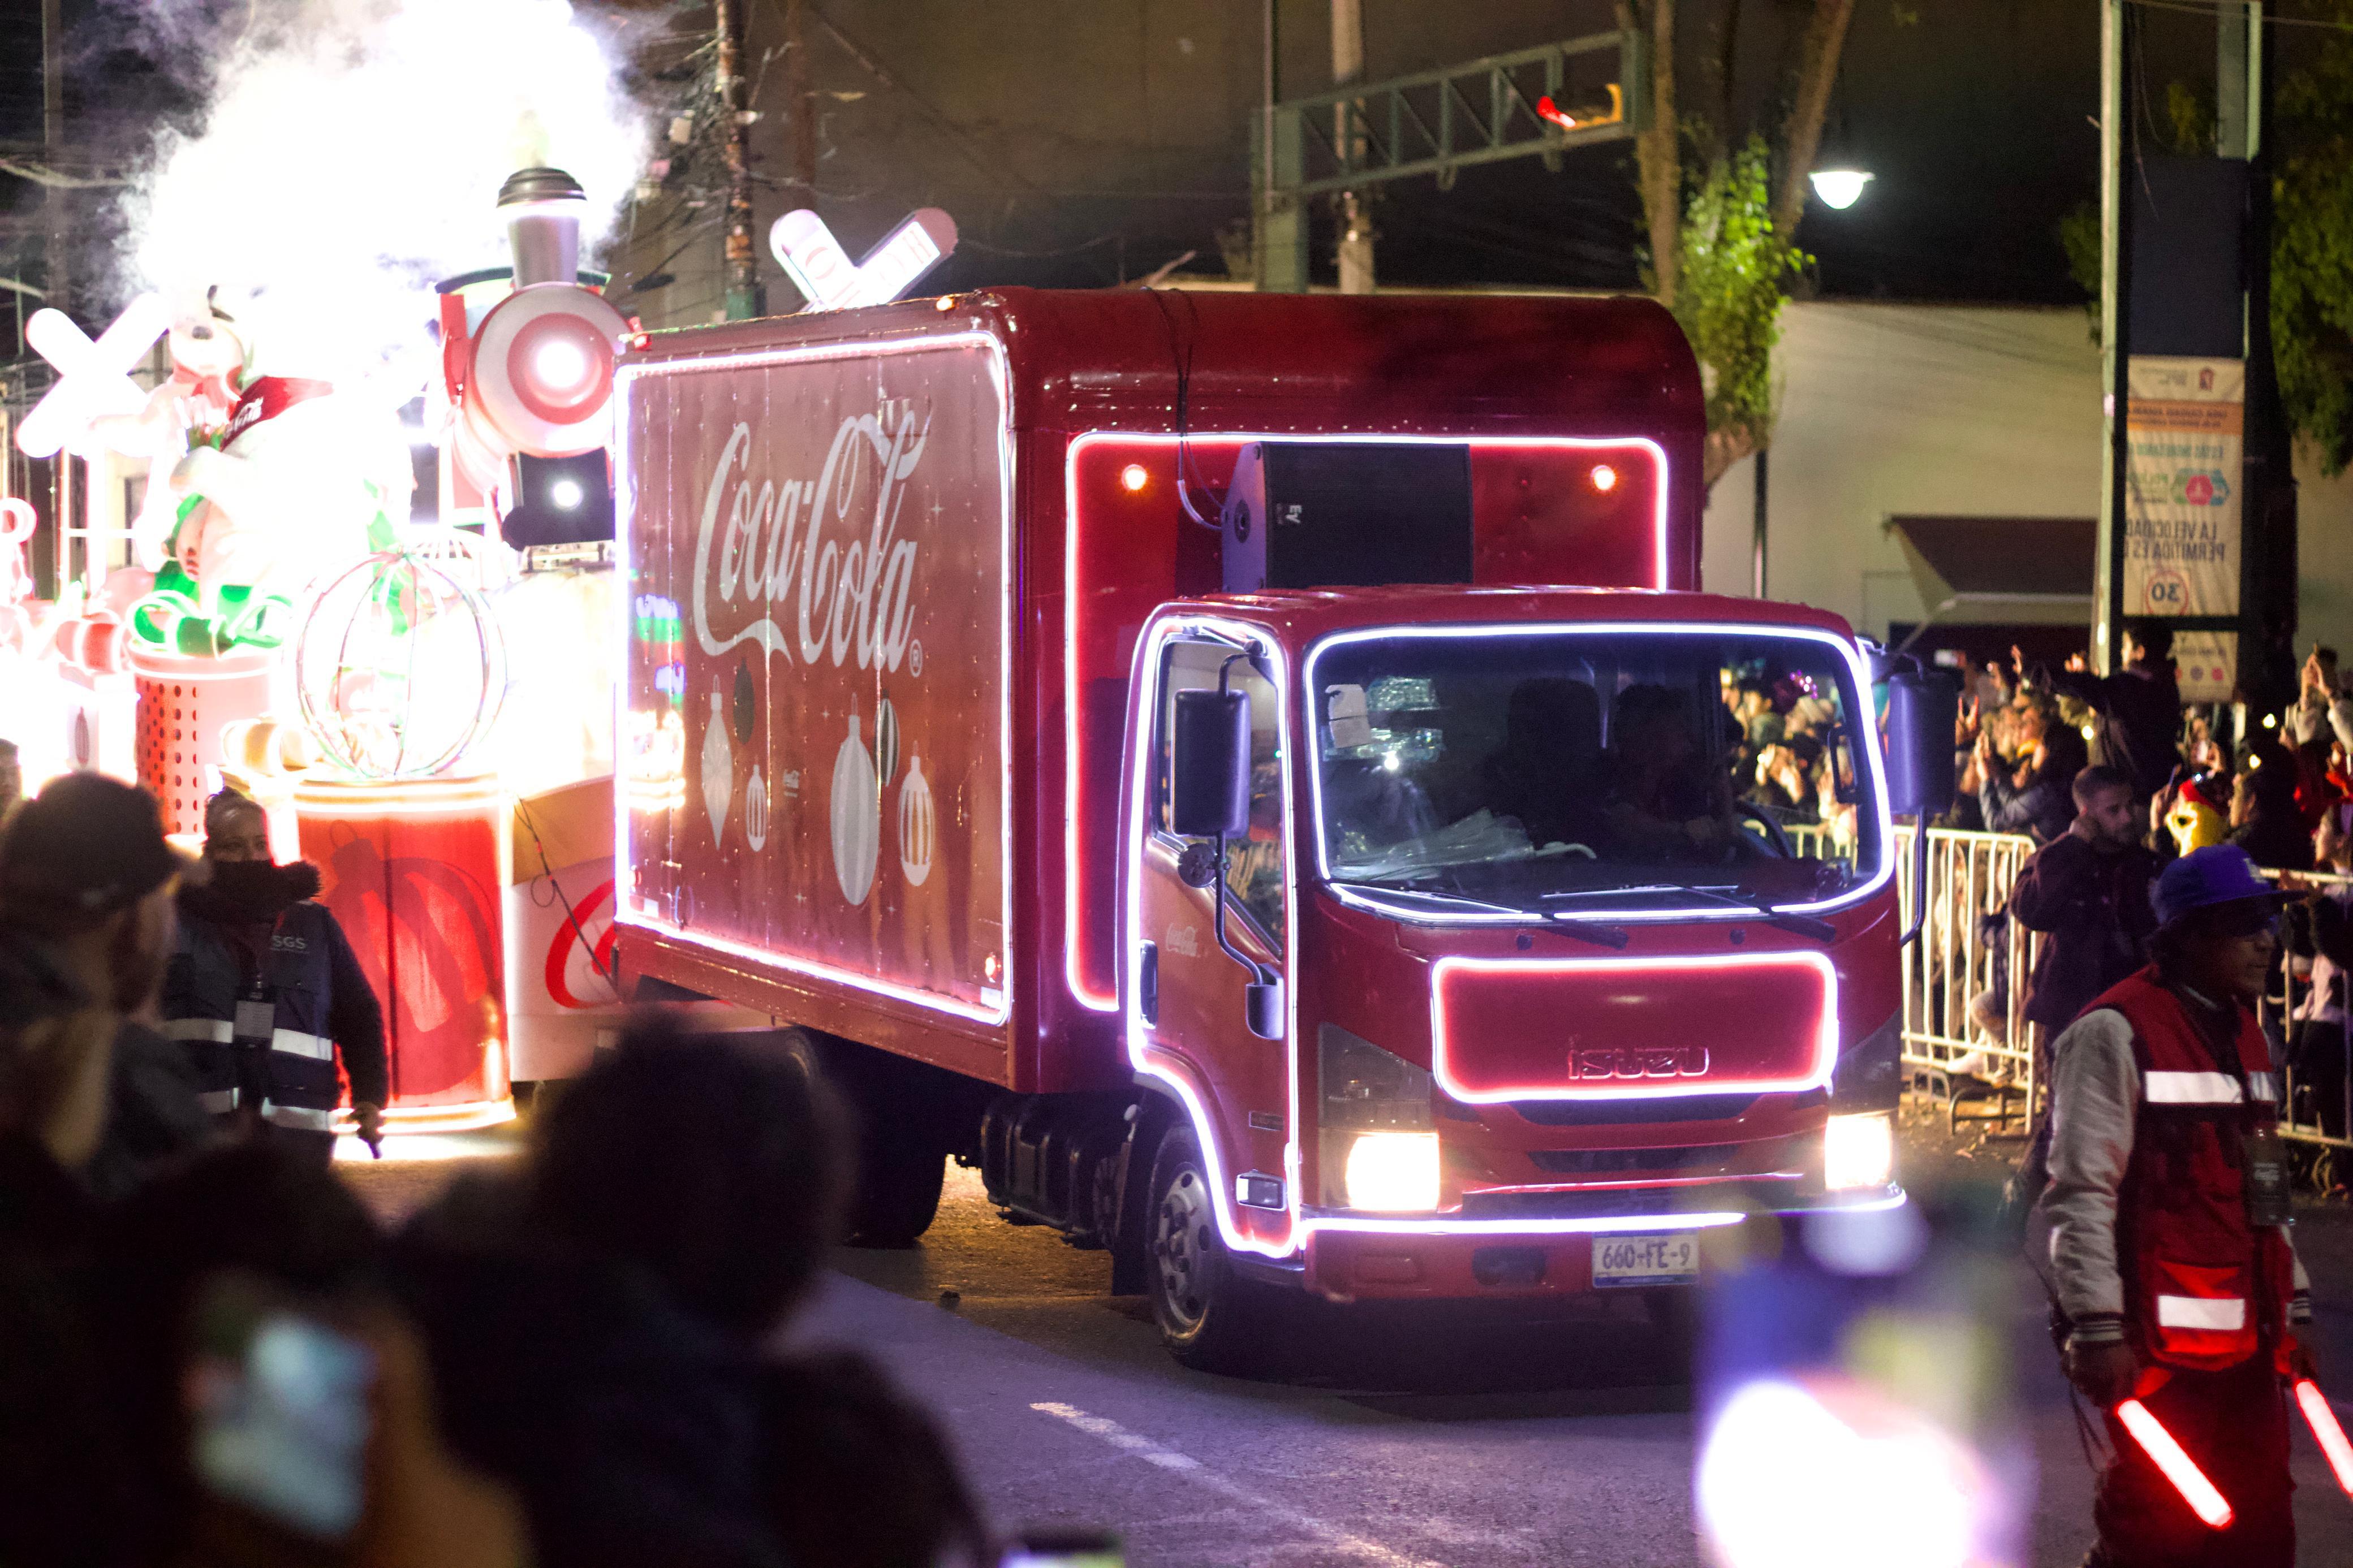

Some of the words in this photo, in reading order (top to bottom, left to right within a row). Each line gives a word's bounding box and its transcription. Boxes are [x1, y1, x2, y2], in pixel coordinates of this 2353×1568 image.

[693, 410, 931, 673] Coca-Cola
[1567, 1047, 1710, 1079] ISUZU
[1602, 1241, 1690, 1269] 660-FE-9
